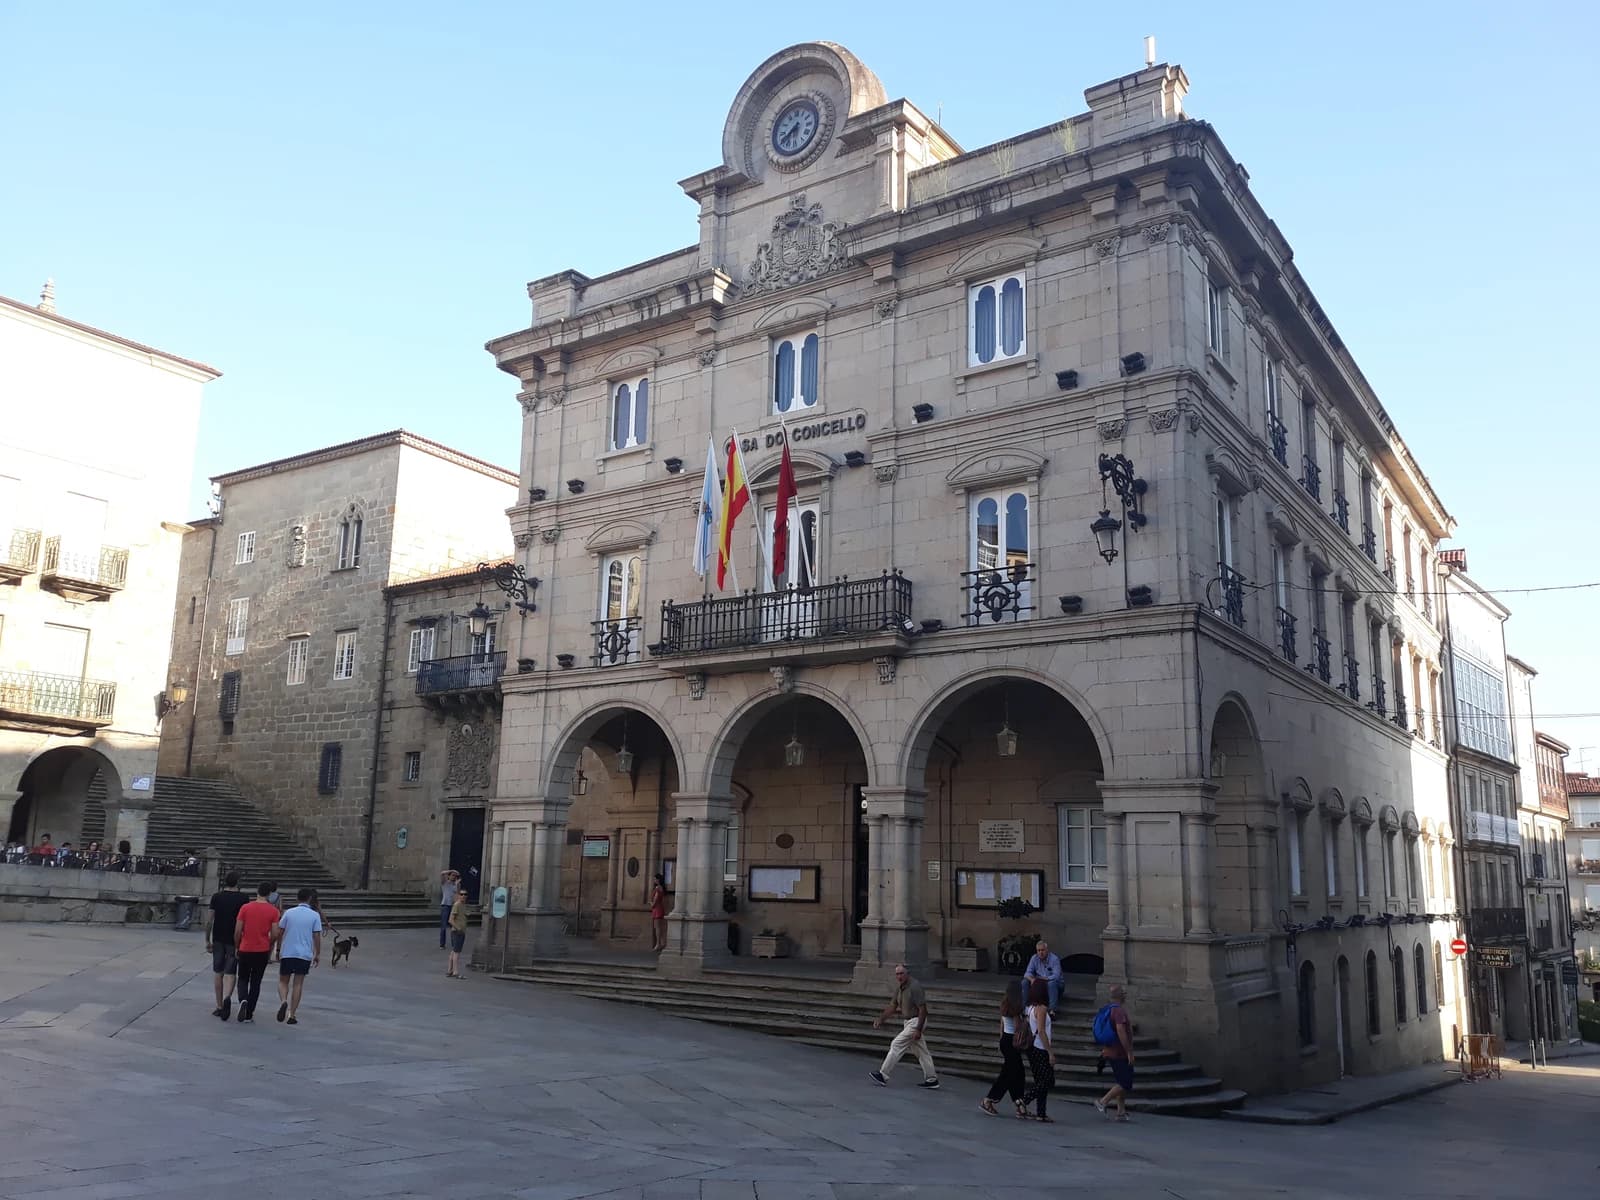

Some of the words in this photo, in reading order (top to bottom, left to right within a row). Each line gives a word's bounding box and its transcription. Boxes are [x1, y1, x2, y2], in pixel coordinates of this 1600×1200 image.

[725, 437, 759, 456] CSA
[766, 431, 785, 449] DO
[791, 413, 866, 442] CONCELLO
